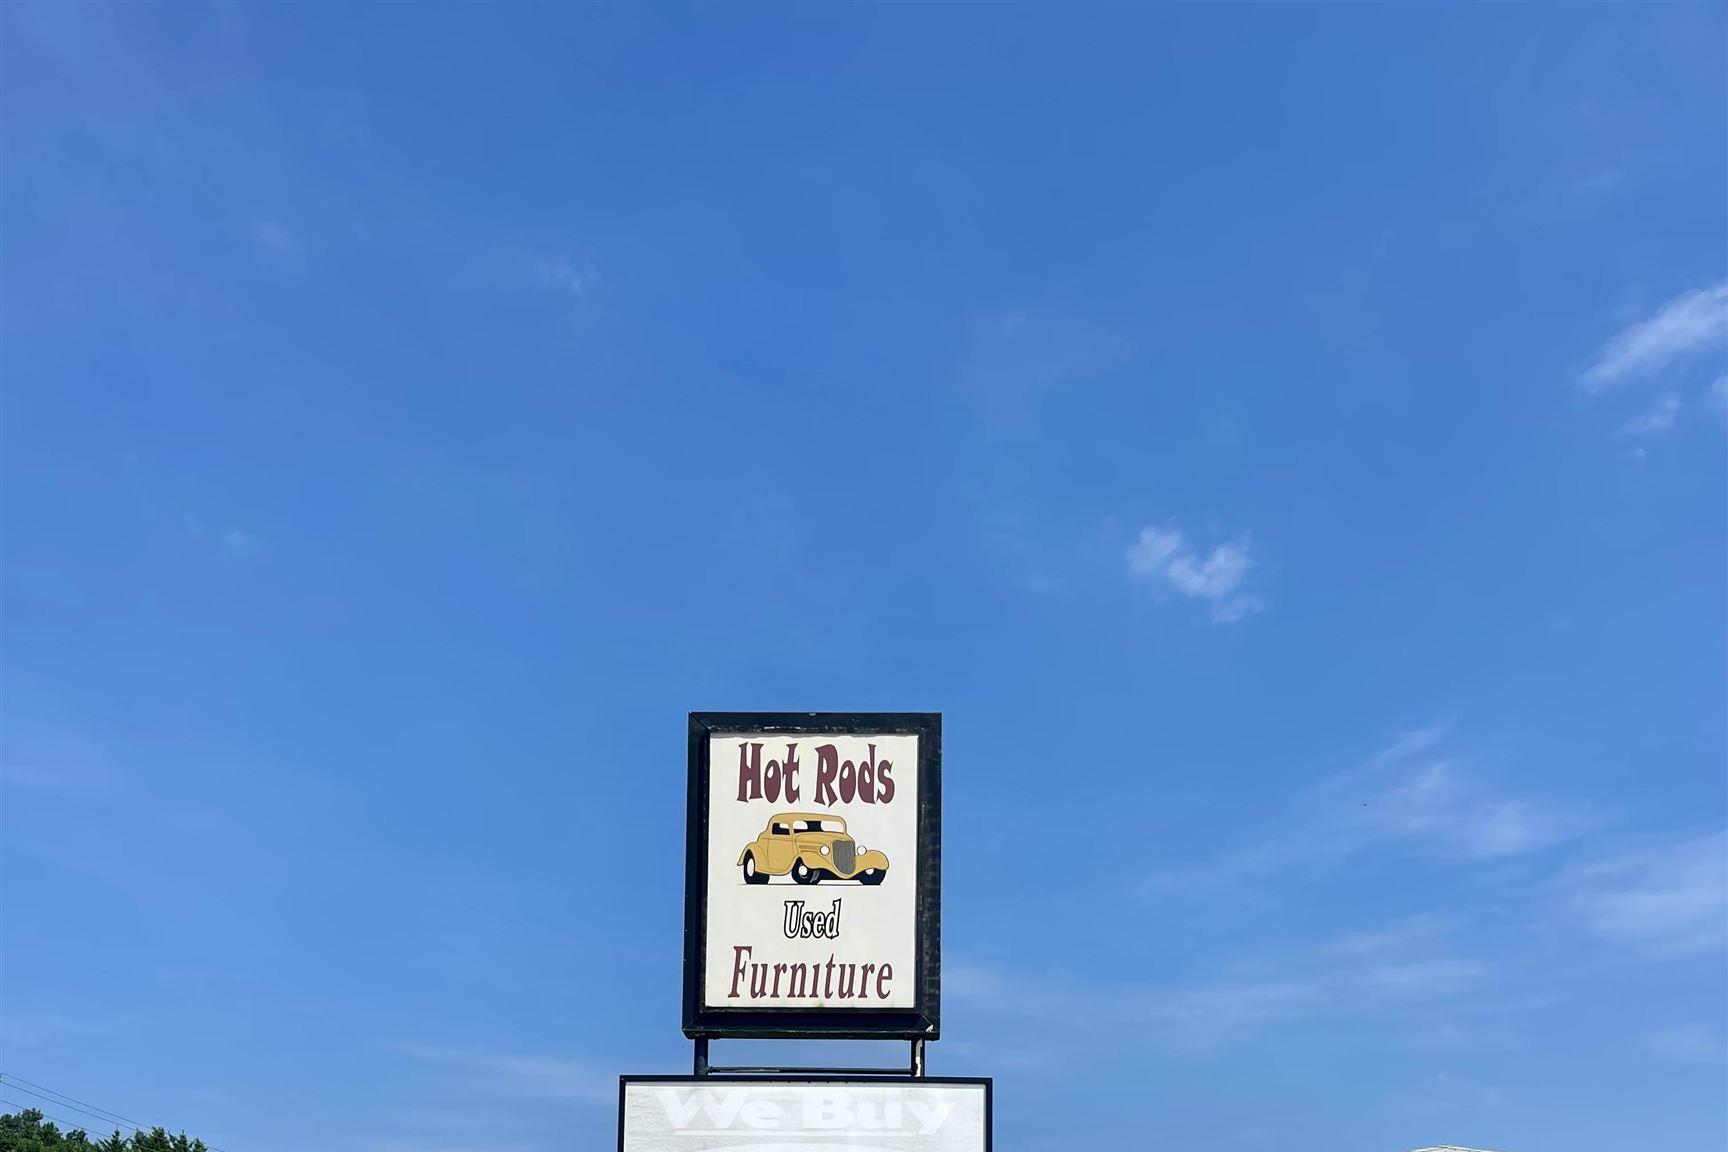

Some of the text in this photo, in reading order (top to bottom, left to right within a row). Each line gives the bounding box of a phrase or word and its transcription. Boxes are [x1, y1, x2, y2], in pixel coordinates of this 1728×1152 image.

[736, 742, 896, 808] Hot Rods
[783, 898, 842, 940] Used
[728, 945, 893, 1000] Furniture
[656, 1087, 782, 1129] We
